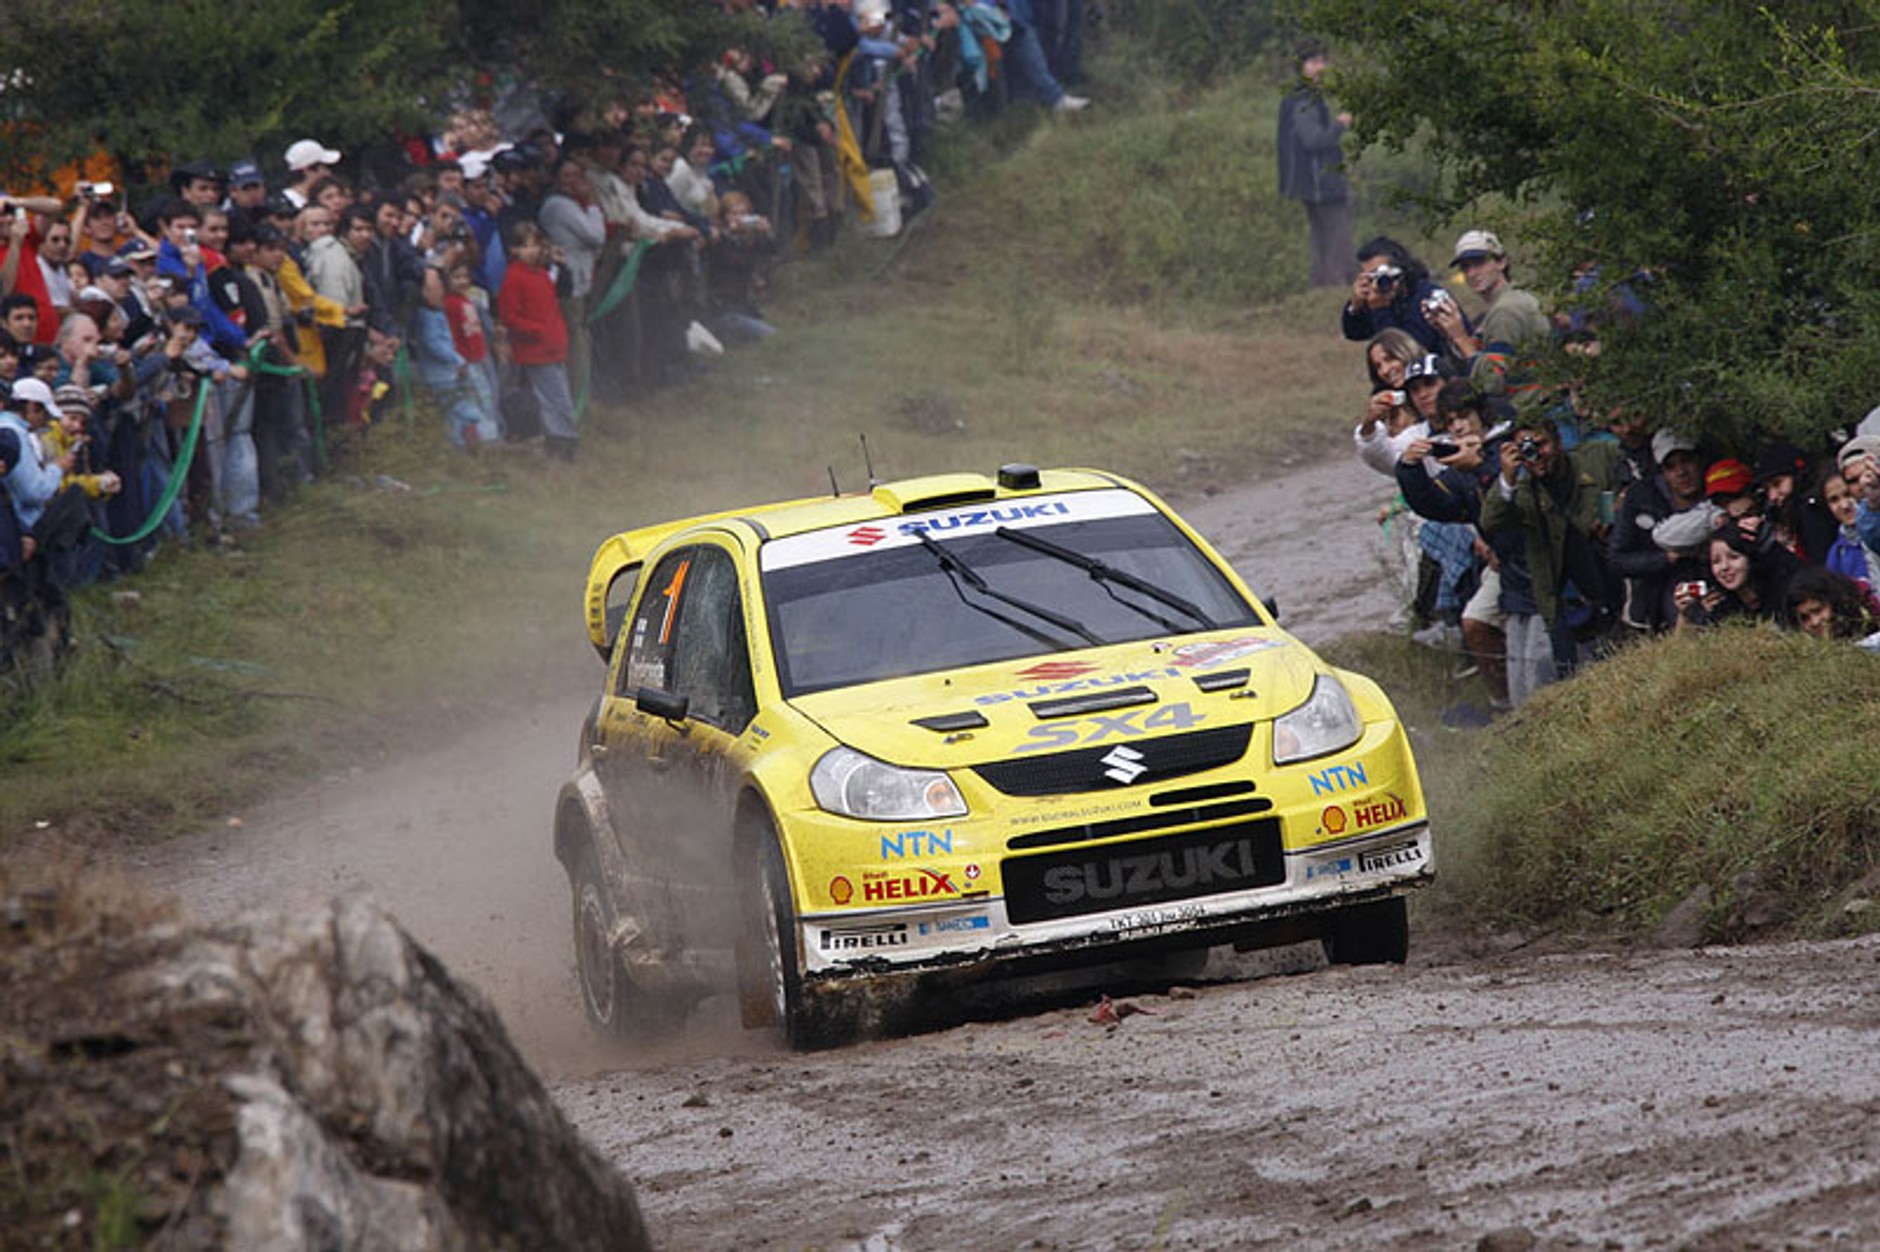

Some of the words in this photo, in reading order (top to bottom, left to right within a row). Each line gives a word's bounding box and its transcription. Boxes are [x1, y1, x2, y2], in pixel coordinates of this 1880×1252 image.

[897, 502, 1070, 536] SUZUKI
[657, 560, 691, 645] 1
[974, 667, 1182, 706] SUZUKI
[1012, 702, 1207, 753] SX4
[1308, 760, 1369, 796] NTN
[881, 829, 953, 860] NTN
[1357, 840, 1423, 873] PIRELLI
[863, 869, 958, 901] HELIX
[1042, 838, 1257, 905] SUZUKI
[820, 922, 908, 950] PIRELLI
